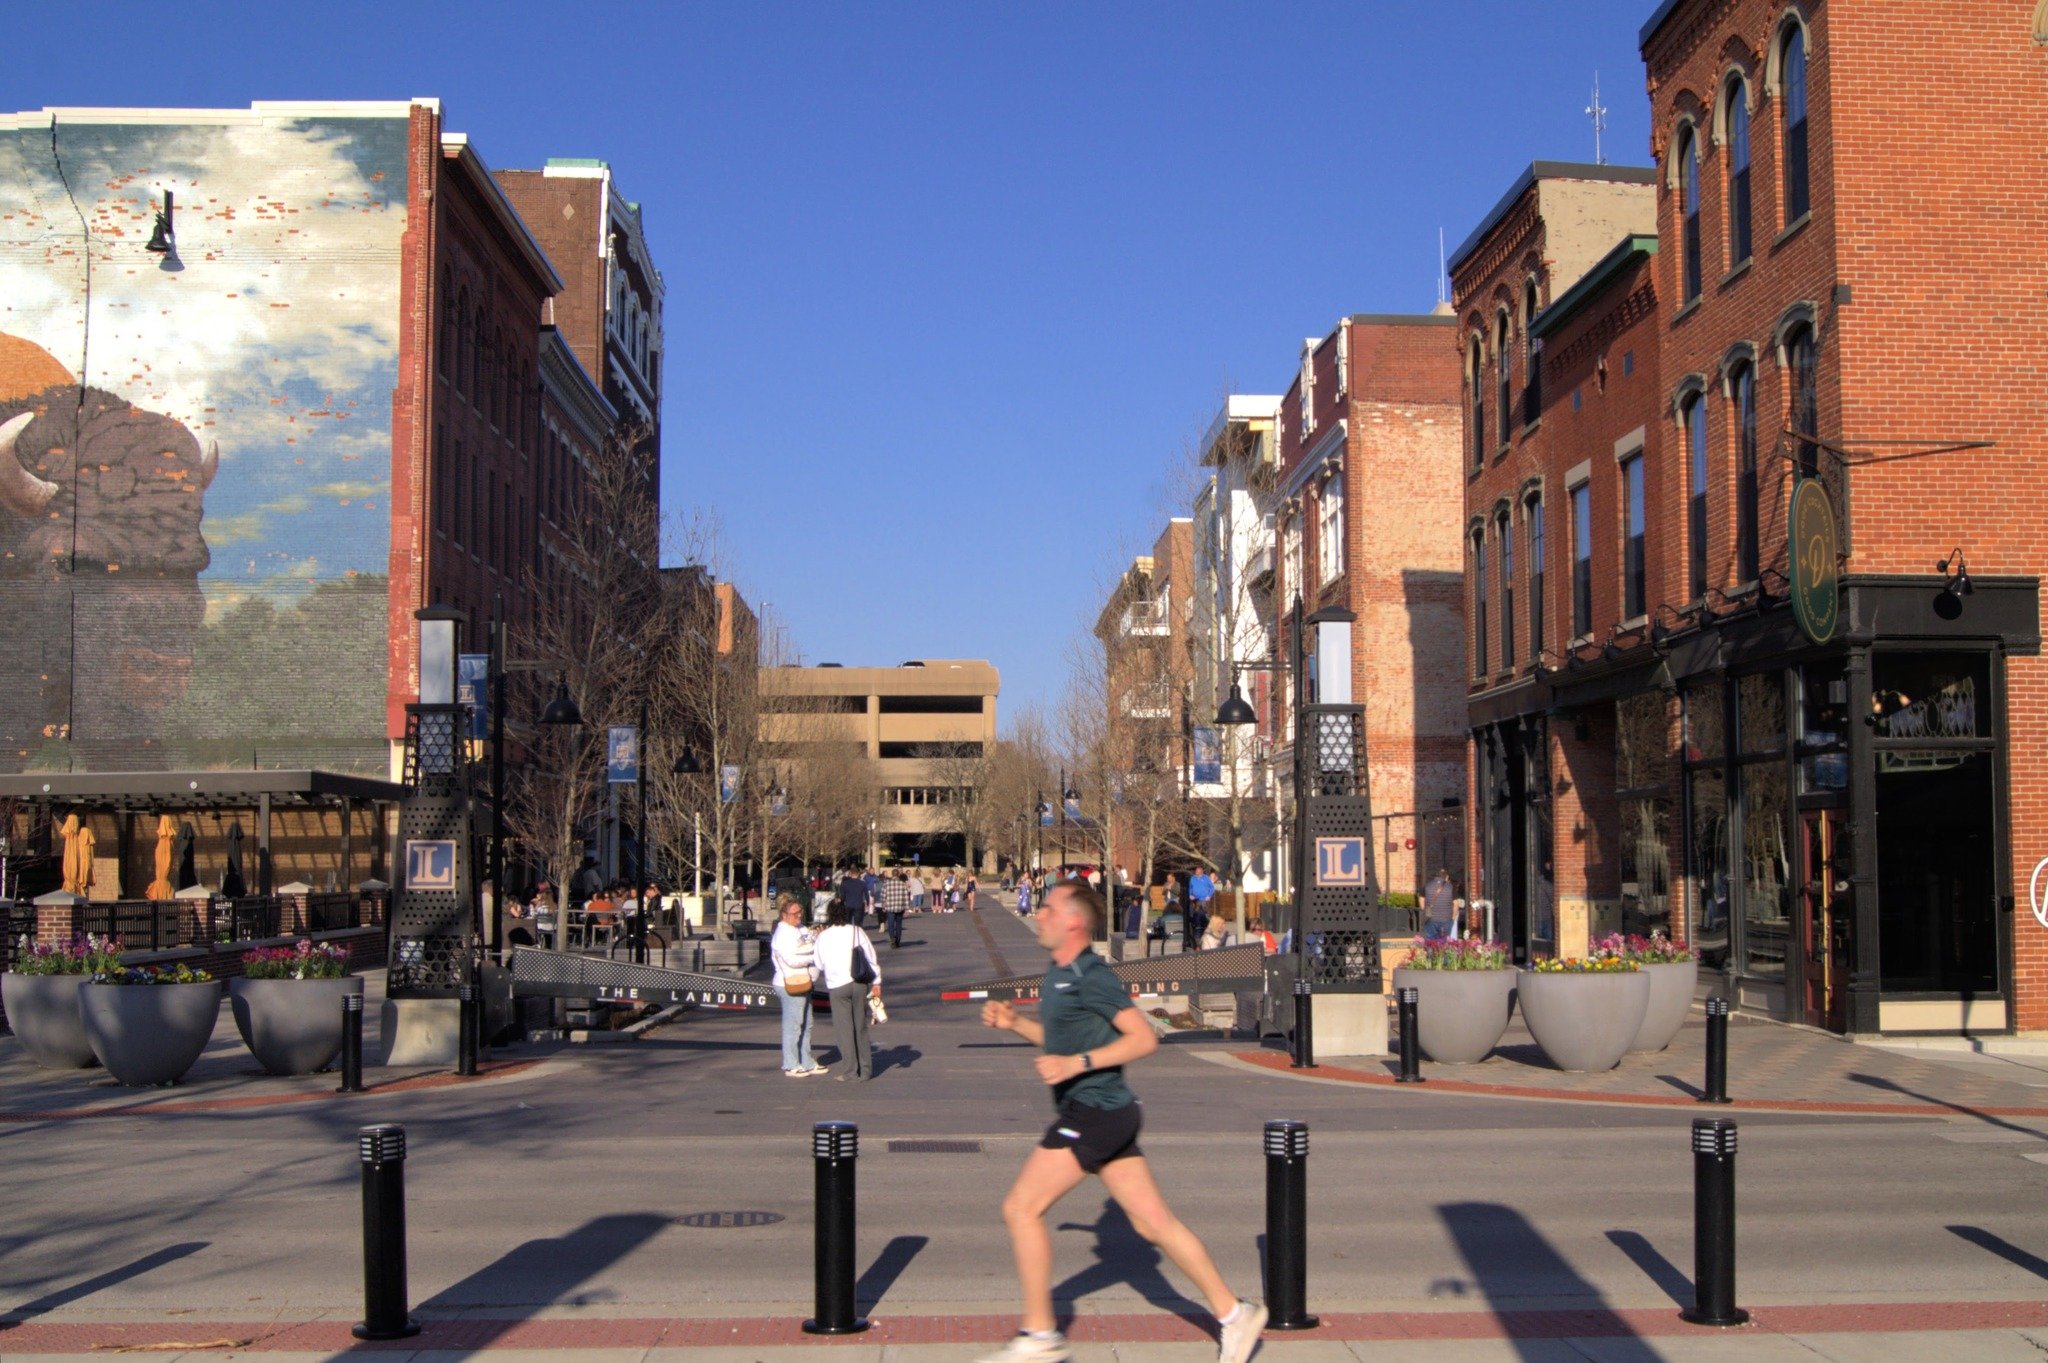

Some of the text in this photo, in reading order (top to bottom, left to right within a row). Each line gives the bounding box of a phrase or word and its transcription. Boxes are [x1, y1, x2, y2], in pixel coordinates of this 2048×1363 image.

[413, 846, 449, 882] L
[1322, 844, 1359, 880] L
[600, 986, 767, 1006] THE LANDING
[1015, 988, 1040, 999] TH
